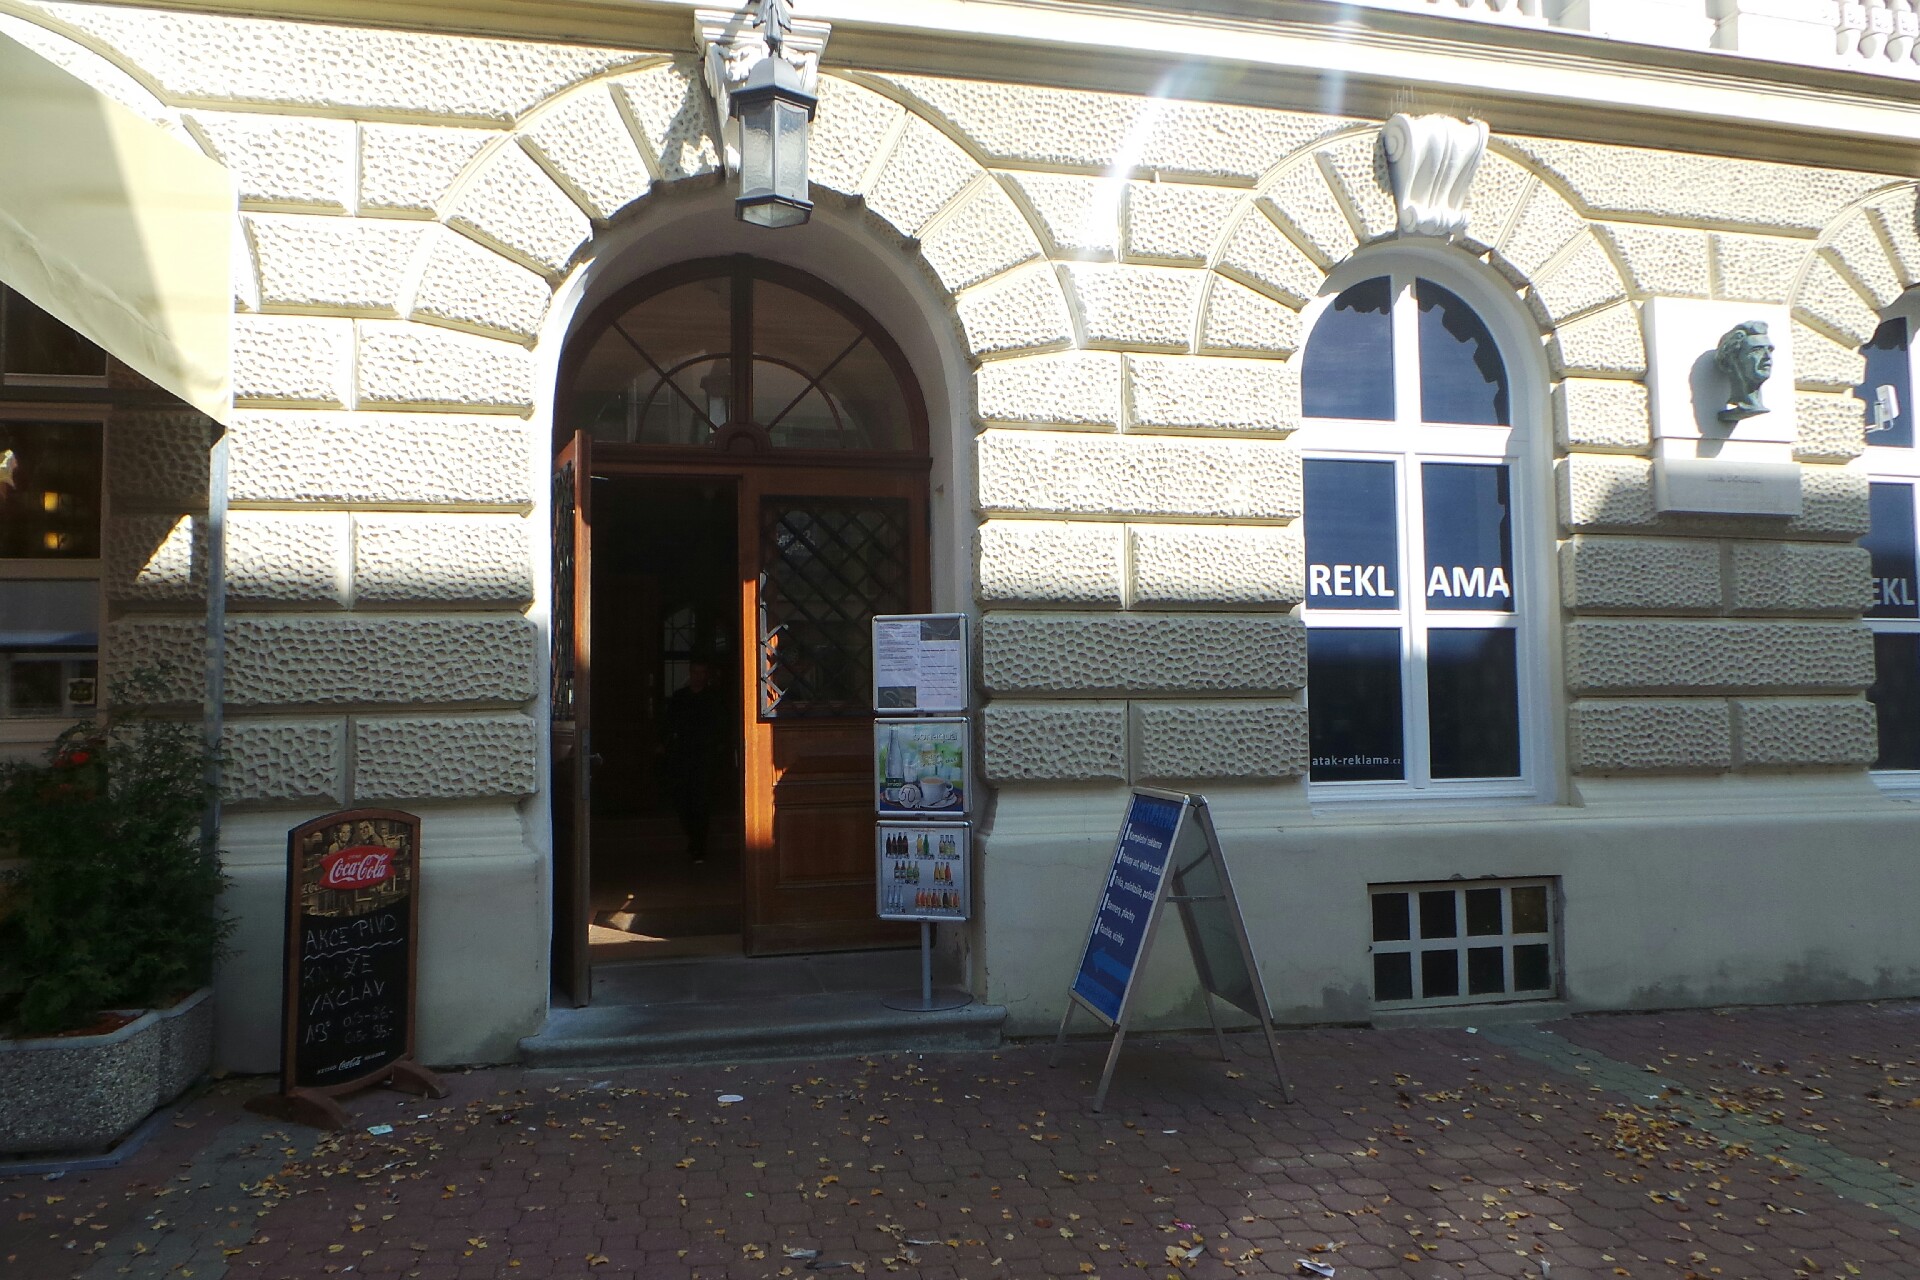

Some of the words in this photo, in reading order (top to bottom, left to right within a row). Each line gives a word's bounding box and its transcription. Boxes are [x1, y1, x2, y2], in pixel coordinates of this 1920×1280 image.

[1309, 565, 1395, 597] REKL
[1426, 566, 1511, 598] AMA
[1312, 754, 1401, 767] atak-reklama.cz
[328, 853, 389, 884] Coca-Cola
[304, 926, 350, 954] AKCE
[351, 913, 397, 937] PIVO
